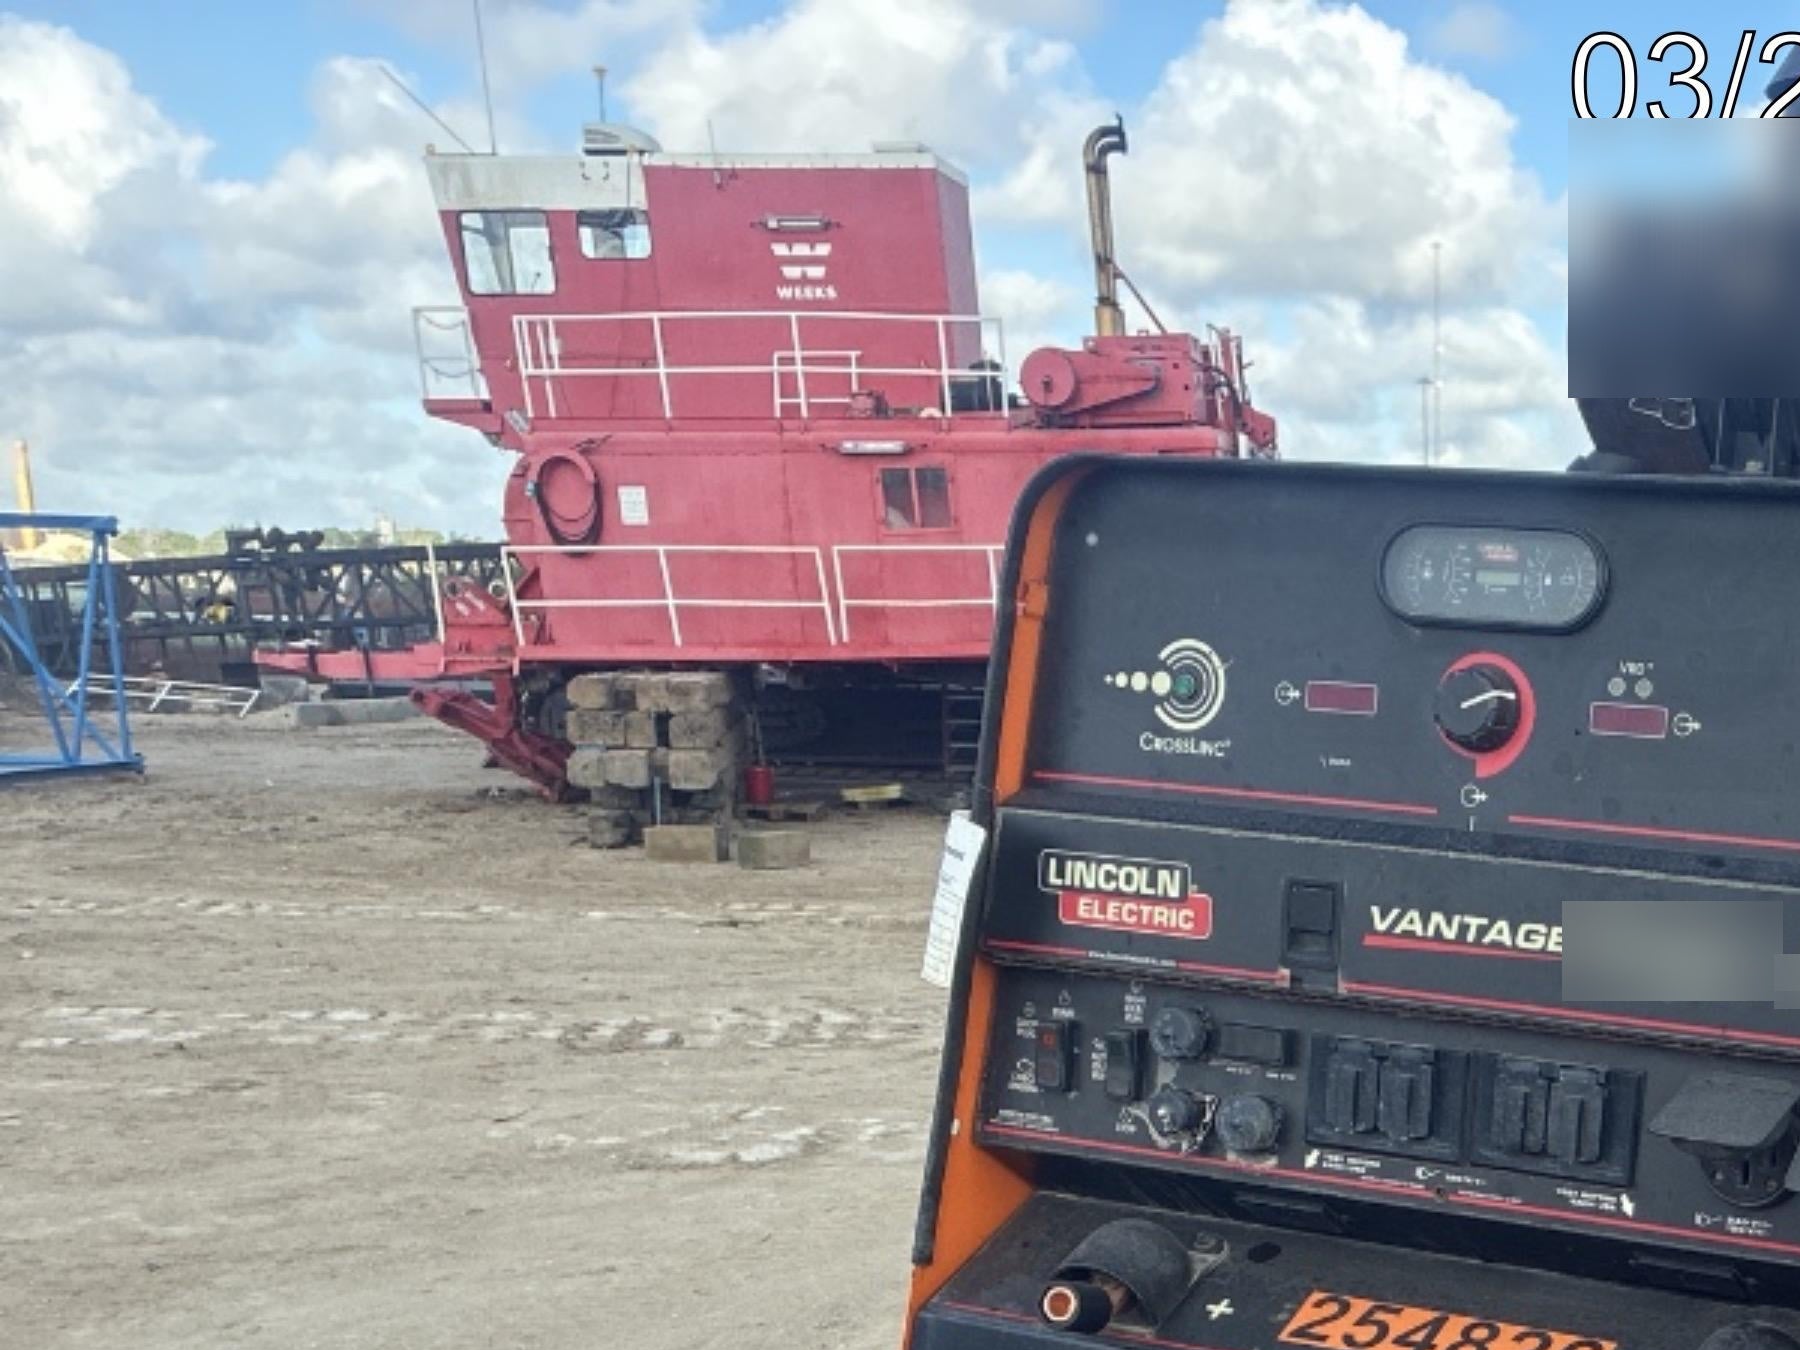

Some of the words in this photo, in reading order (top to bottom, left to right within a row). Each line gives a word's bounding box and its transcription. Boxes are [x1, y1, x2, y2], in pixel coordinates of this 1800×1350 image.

[776, 285, 838, 300] WEEKS
[1049, 857, 1182, 899] LINCOLN
[1076, 898, 1196, 931] ELECTRIC
[1368, 904, 1562, 951] VANTAGE
